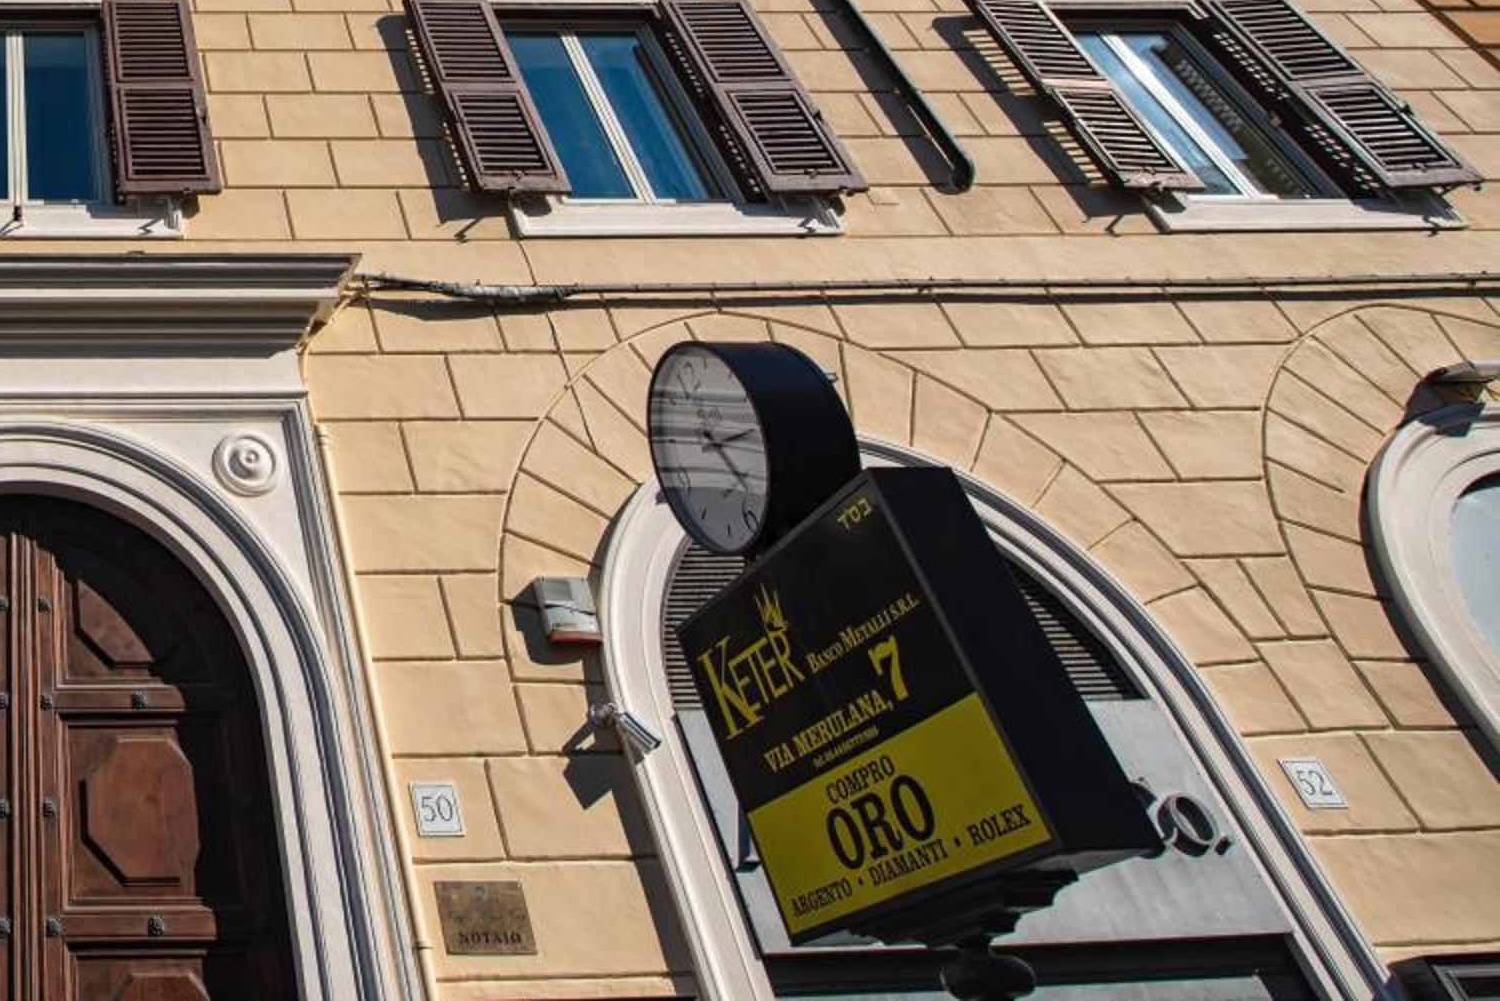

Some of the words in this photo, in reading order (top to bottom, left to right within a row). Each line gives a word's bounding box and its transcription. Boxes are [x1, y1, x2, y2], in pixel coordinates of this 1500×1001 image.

[763, 743, 795, 772] VIA
[792, 689, 894, 758] MERULANA,
[868, 635, 909, 700] 7
[421, 795, 453, 822] 50
[826, 755, 895, 805] COMPRO
[1296, 769, 1333, 796] 52
[826, 774, 936, 870] ORO
[791, 878, 853, 918] ARGENTO
[868, 838, 949, 886] DIAMANTI
[967, 803, 1032, 847] ROLEX
